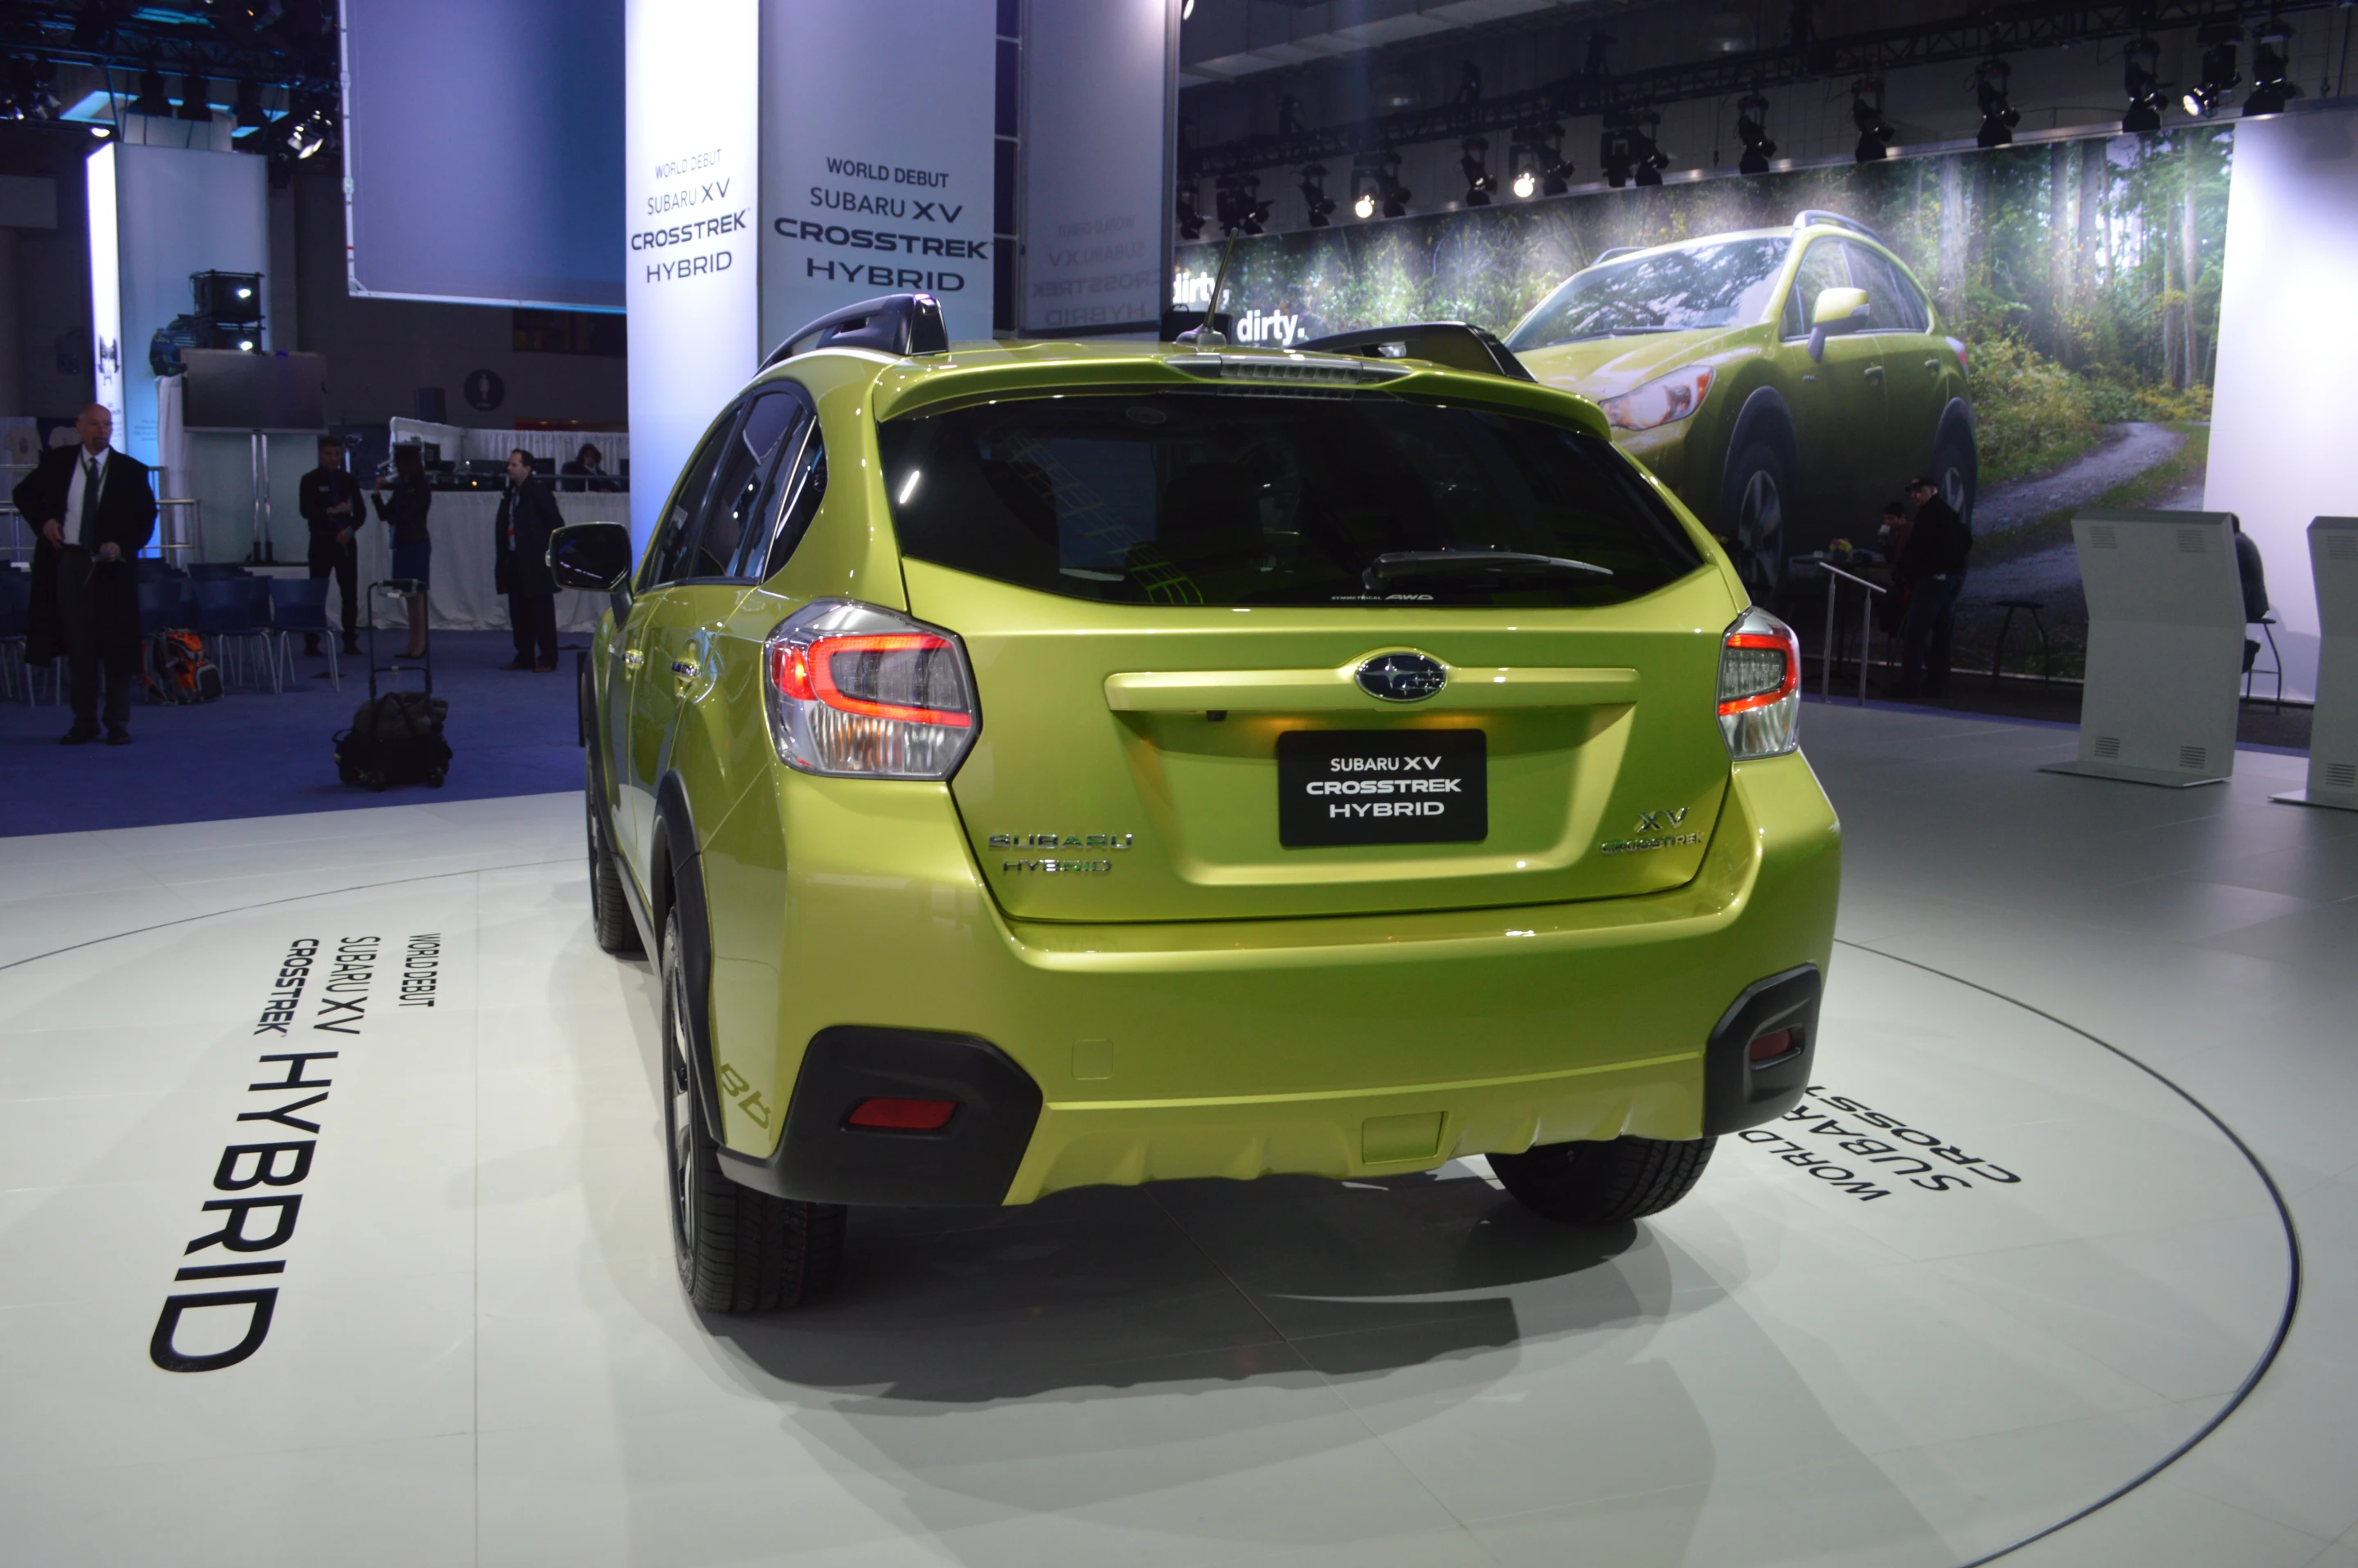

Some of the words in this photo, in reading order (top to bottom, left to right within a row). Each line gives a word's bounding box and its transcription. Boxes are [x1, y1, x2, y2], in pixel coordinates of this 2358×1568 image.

[655, 159, 688, 179] WORLD
[691, 148, 722, 170] DEBUT
[827, 157, 890, 181] WORLD
[894, 167, 949, 188] DEBUT
[648, 188, 697, 215] SUBARU
[702, 178, 730, 203] XV
[810, 187, 906, 218] SUBARU
[912, 201, 963, 224] XV
[631, 209, 747, 251] CROSSTREK
[774, 217, 988, 260] CROSSTREK
[647, 251, 733, 282] HYBRID
[806, 257, 965, 291] HYBRID
[1237, 310, 1305, 346] dirty.
[1330, 757, 1399, 771] SUBARU
[1403, 757, 1442, 770] XV
[1306, 779, 1462, 795] CROSSTREK
[1330, 802, 1445, 818] HYBRID
[1634, 807, 1690, 833] XV
[989, 834, 1132, 849] SUBARU
[1601, 832, 1705, 854] CROSSTREK
[1003, 859, 1112, 872] HYBRID
[325, 936, 381, 992] SUBARU
[405, 933, 441, 969] WORLD
[253, 938, 320, 1037] CROSSTREK
[398, 971, 437, 1007] DEBUT
[313, 996, 368, 1035] XV
[1738, 1130, 1891, 1201] WORLD
[150, 1051, 340, 1373] HYBRID
